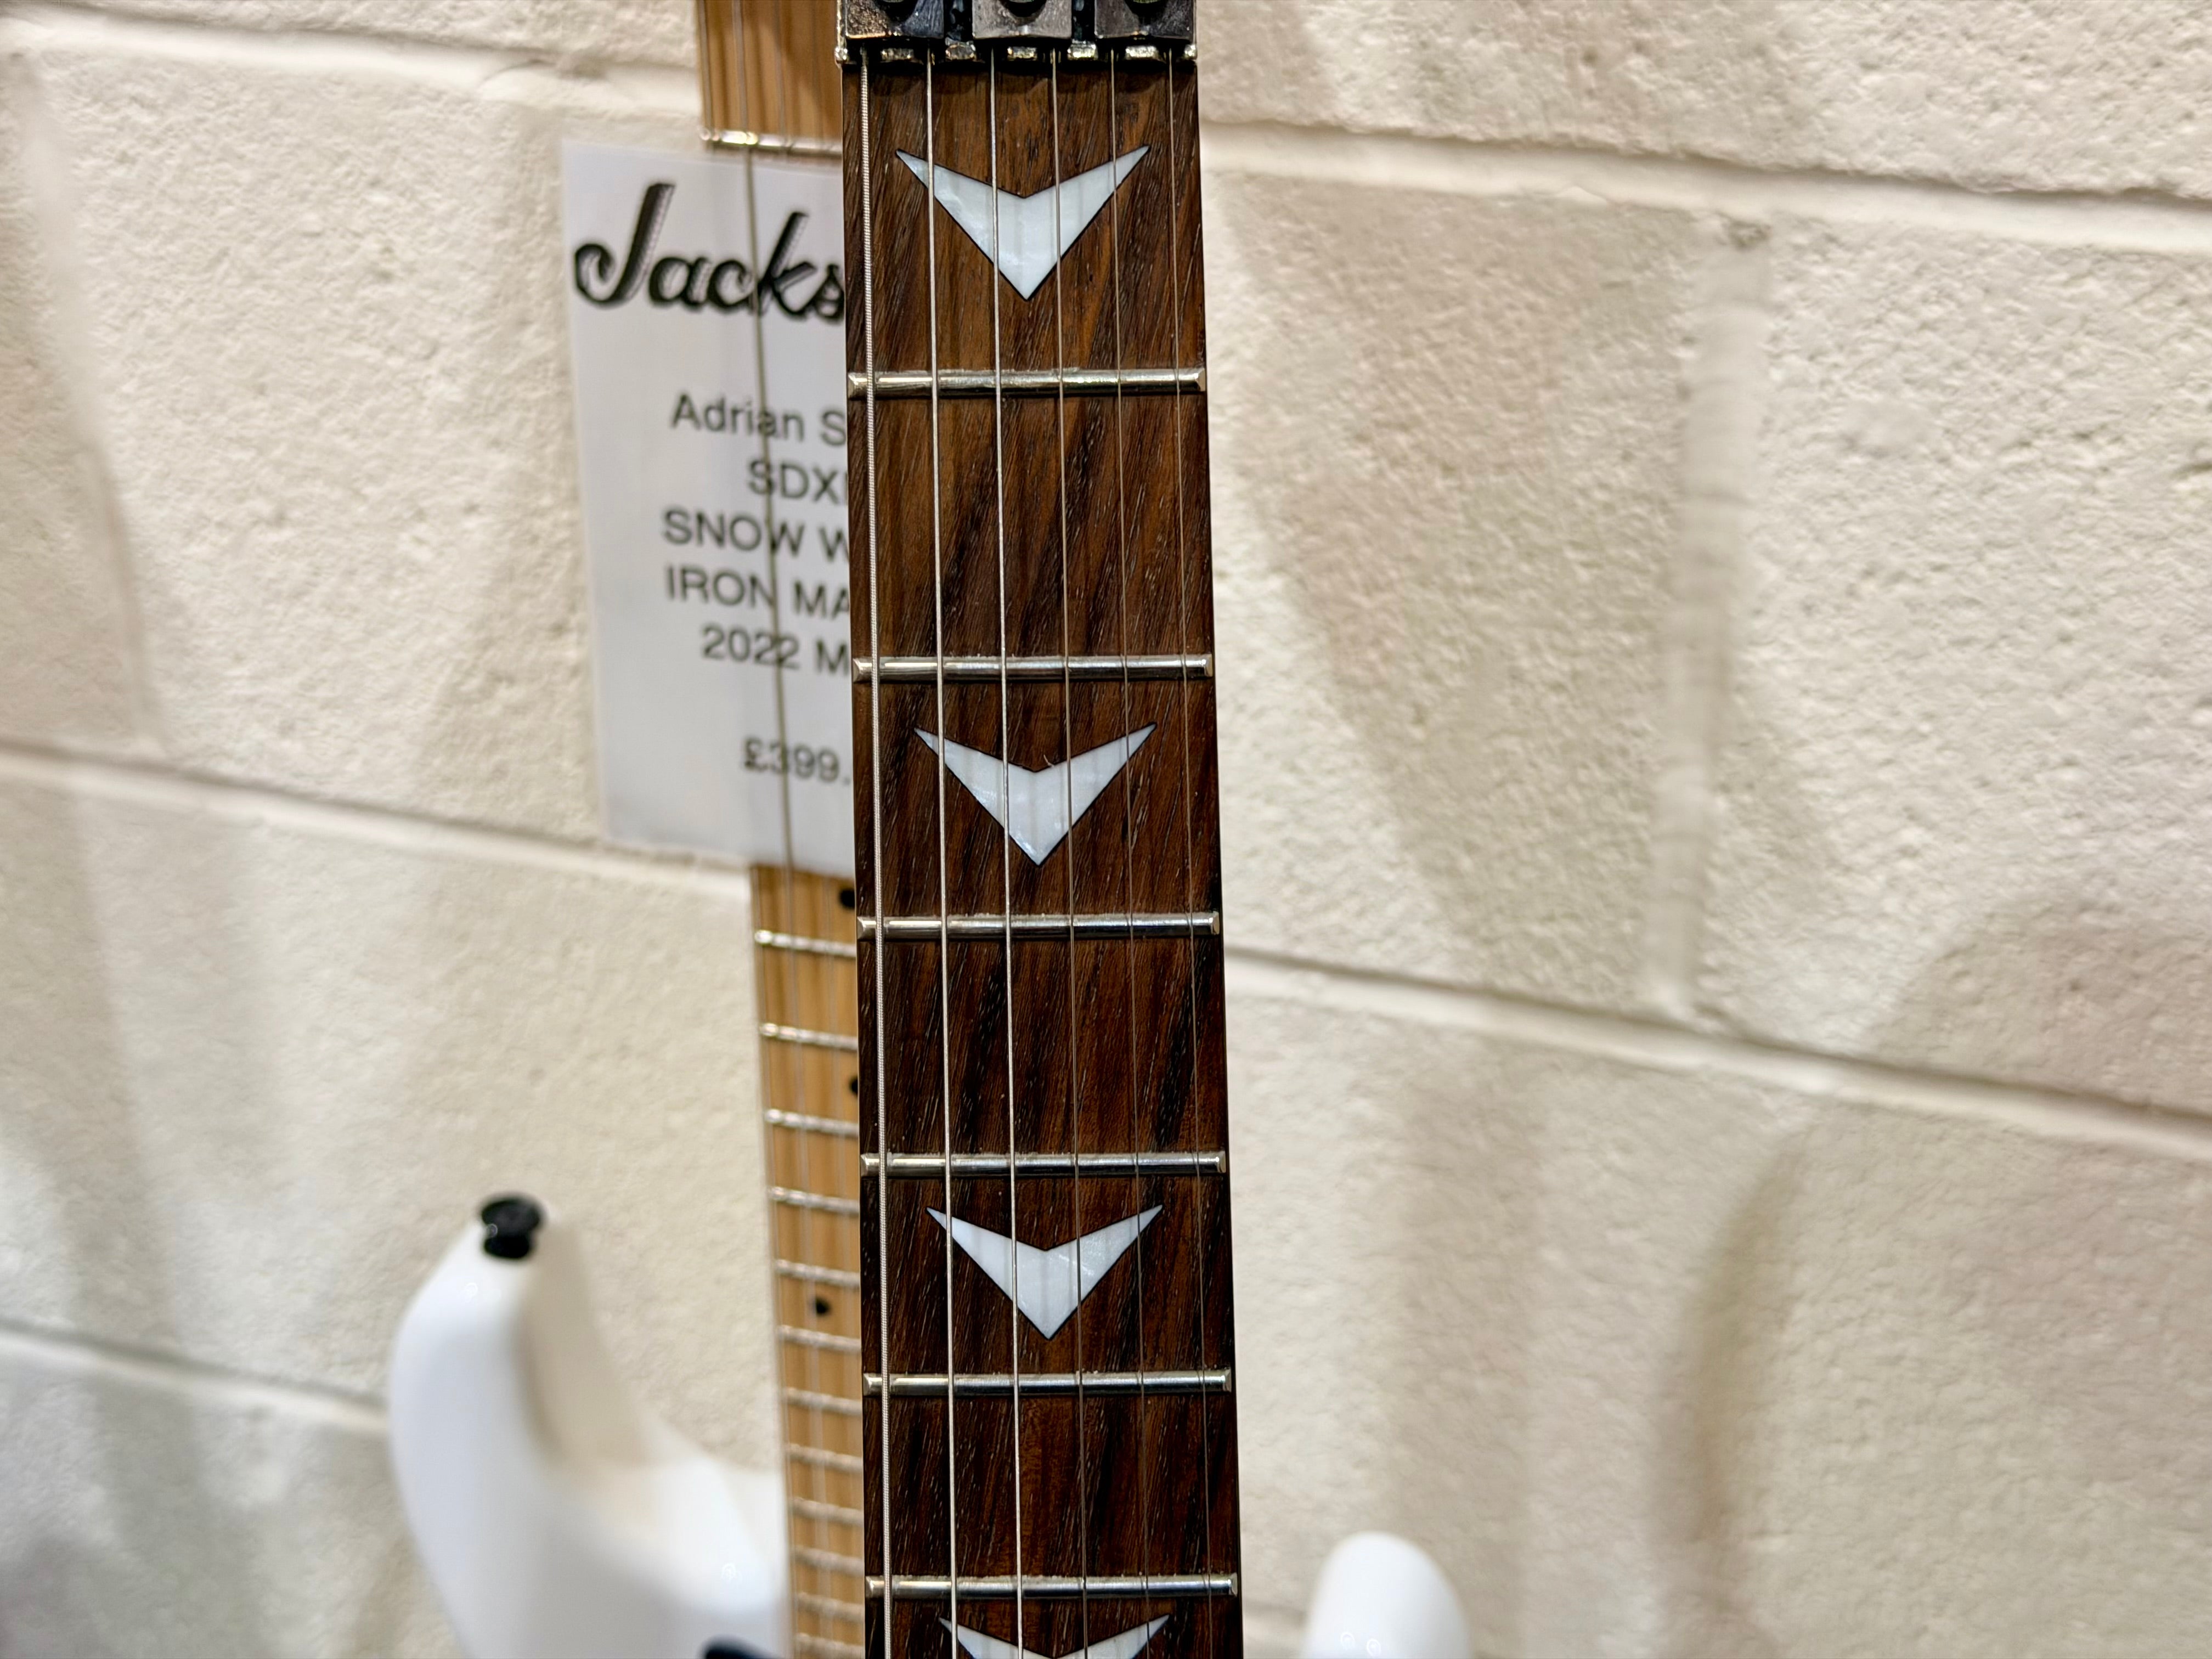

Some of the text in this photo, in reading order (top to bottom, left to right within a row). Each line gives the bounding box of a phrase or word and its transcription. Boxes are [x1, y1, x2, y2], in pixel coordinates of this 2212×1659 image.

[669, 392, 804, 442] Adrian
[747, 458, 848, 506] SDX
[662, 506, 805, 558] SNOW
[664, 565, 775, 609] IRON
[701, 621, 800, 670] 2022
